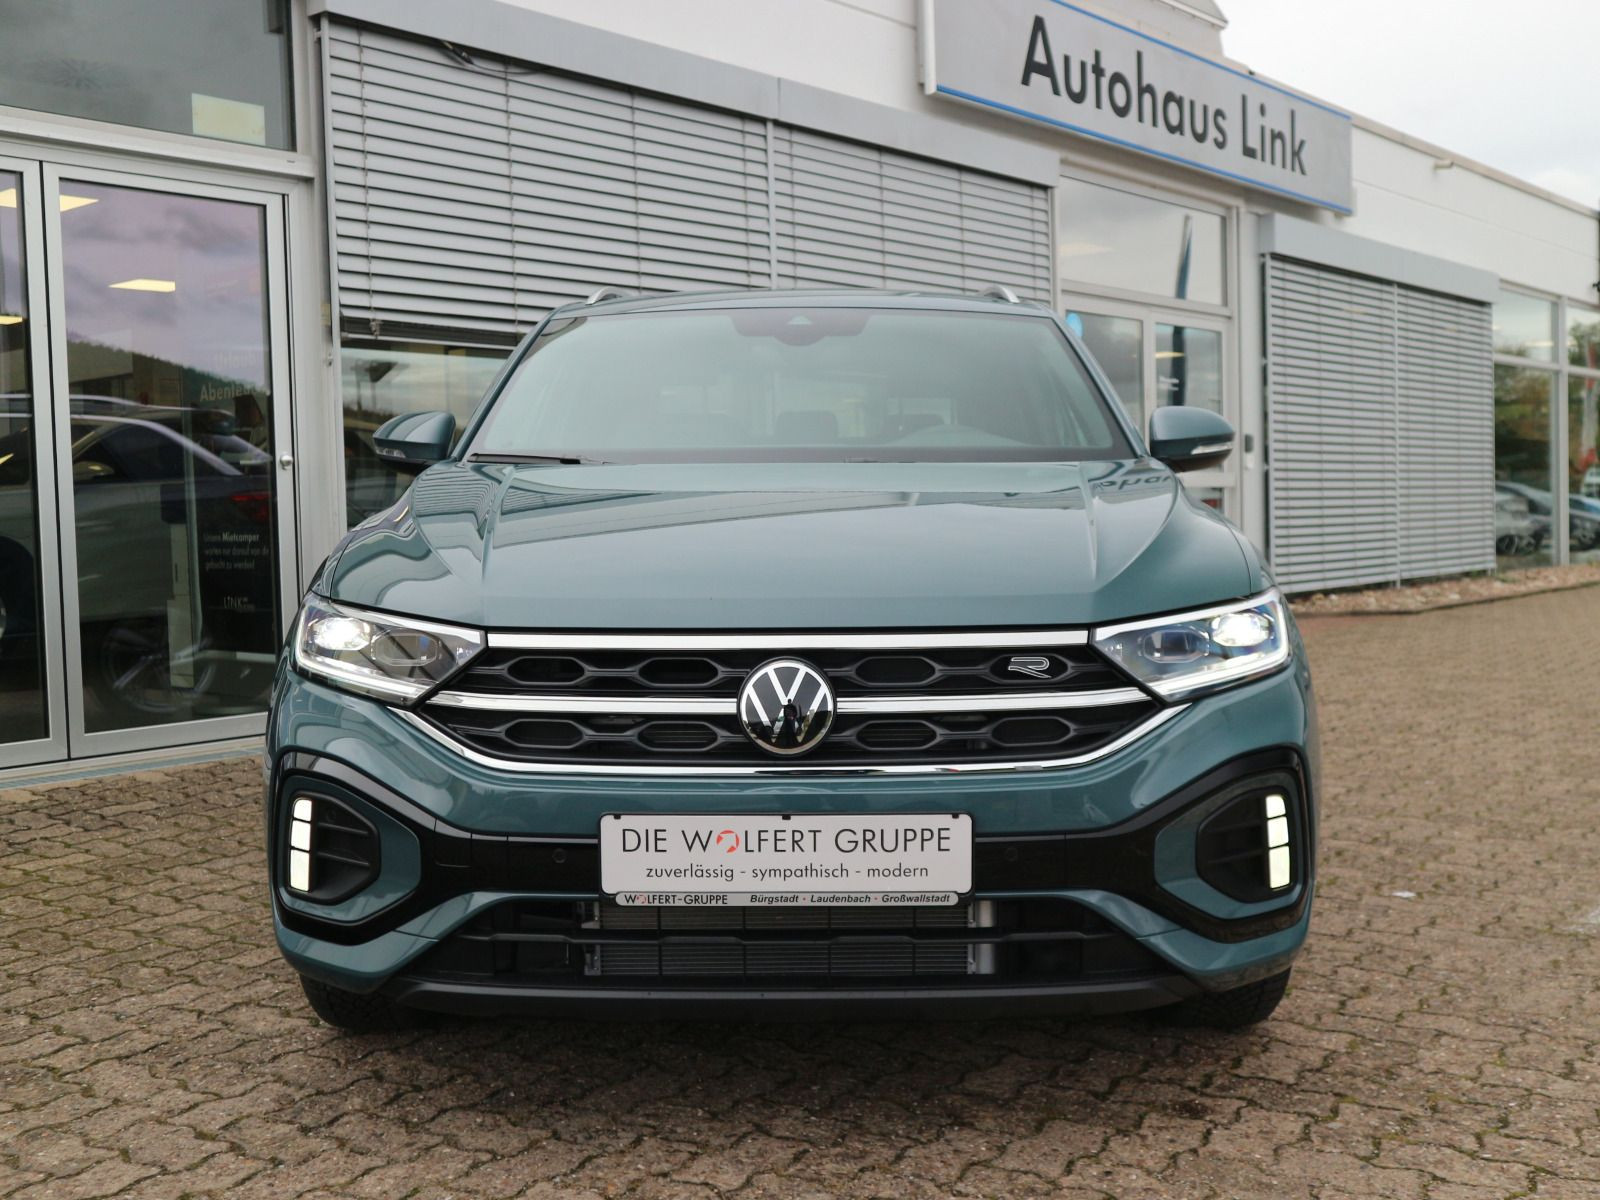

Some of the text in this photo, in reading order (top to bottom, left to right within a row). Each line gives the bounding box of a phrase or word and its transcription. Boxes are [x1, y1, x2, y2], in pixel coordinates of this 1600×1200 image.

[1021, 14, 1307, 176] Autohaus Link
[622, 827, 951, 854] DIE WOLFERT GRUPPE
[646, 862, 734, 882] zuverlässig
[752, 862, 849, 882] sympathisch
[867, 862, 929, 878] modern
[749, 893, 950, 905] Bürgstadt Laudenbach Großwallstadt
